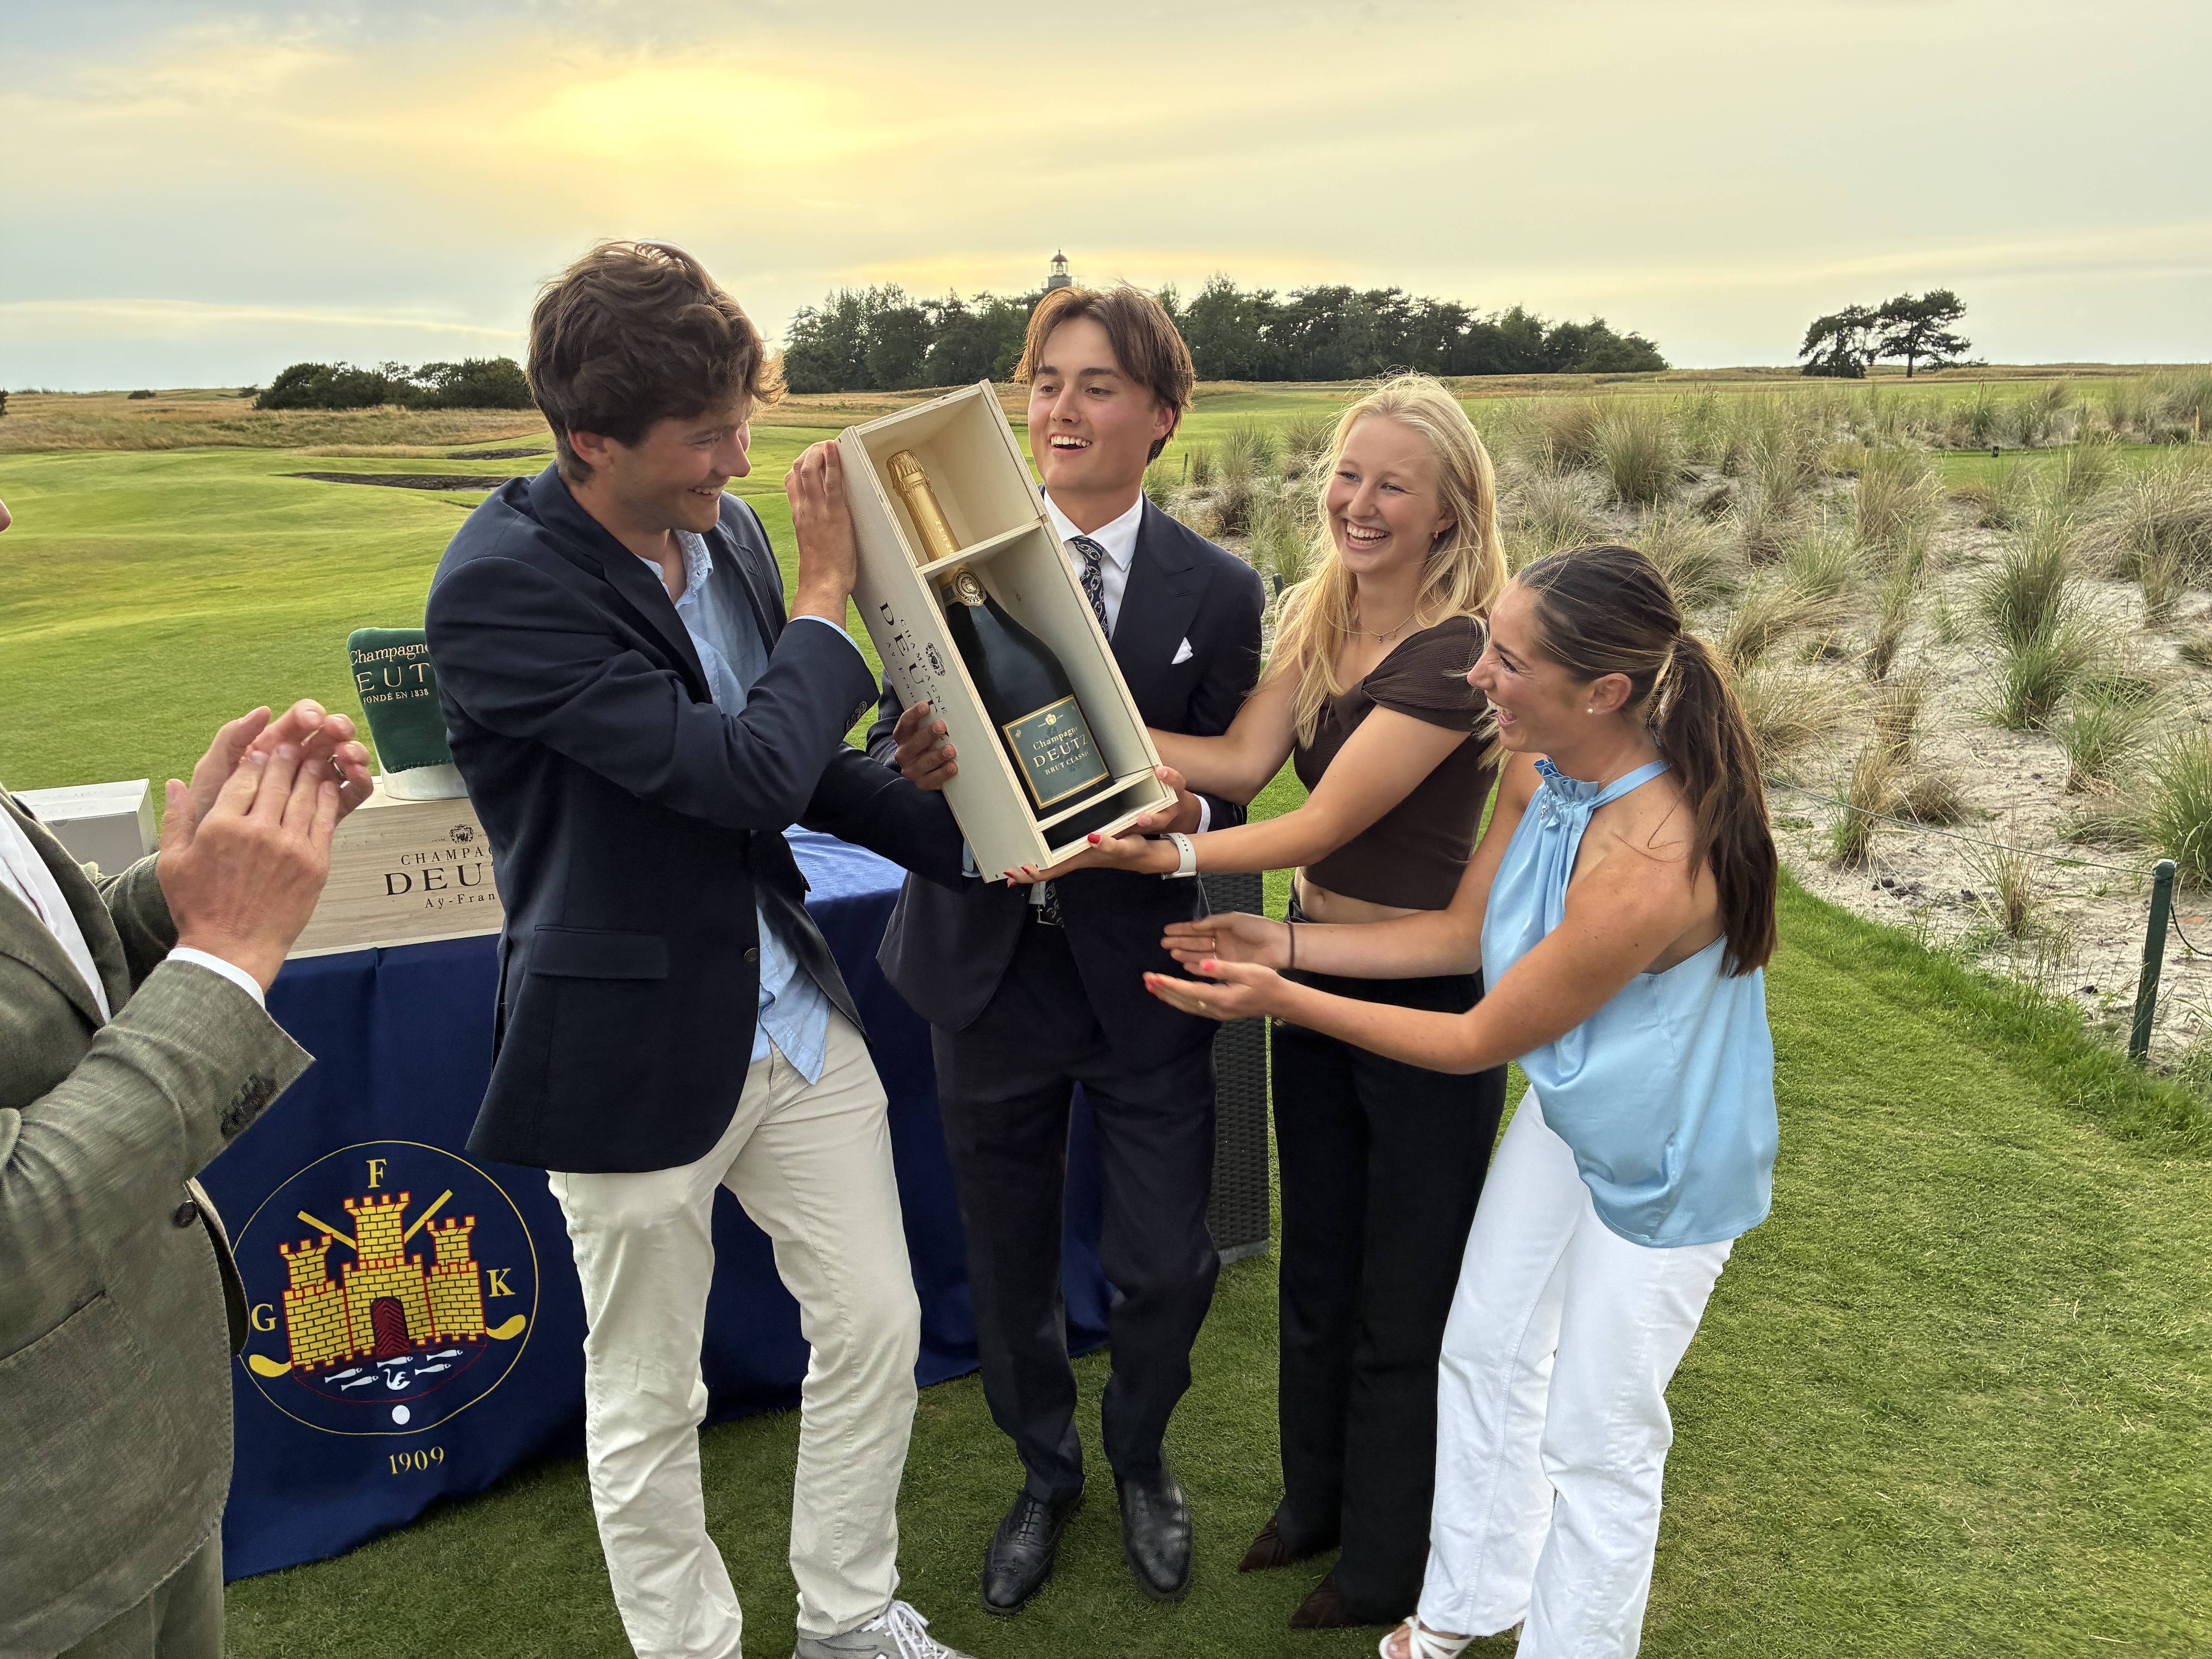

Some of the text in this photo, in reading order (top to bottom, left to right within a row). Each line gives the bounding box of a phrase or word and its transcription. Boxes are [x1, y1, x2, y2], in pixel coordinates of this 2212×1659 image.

[879, 602, 949, 740] DEUT
[901, 619, 947, 714] CHAMPAGNE
[395, 692, 407, 700] EN
[410, 689, 429, 697] 1838
[1033, 725, 1079, 750] Champagne
[1033, 735, 1088, 768] DEUTZ
[1045, 761, 1066, 775] BRUT
[384, 861, 493, 896] DEU
[367, 1158, 388, 1188] F
[487, 1268, 515, 1297] K
[251, 1304, 276, 1331] G
[388, 1446, 445, 1475] 1909
